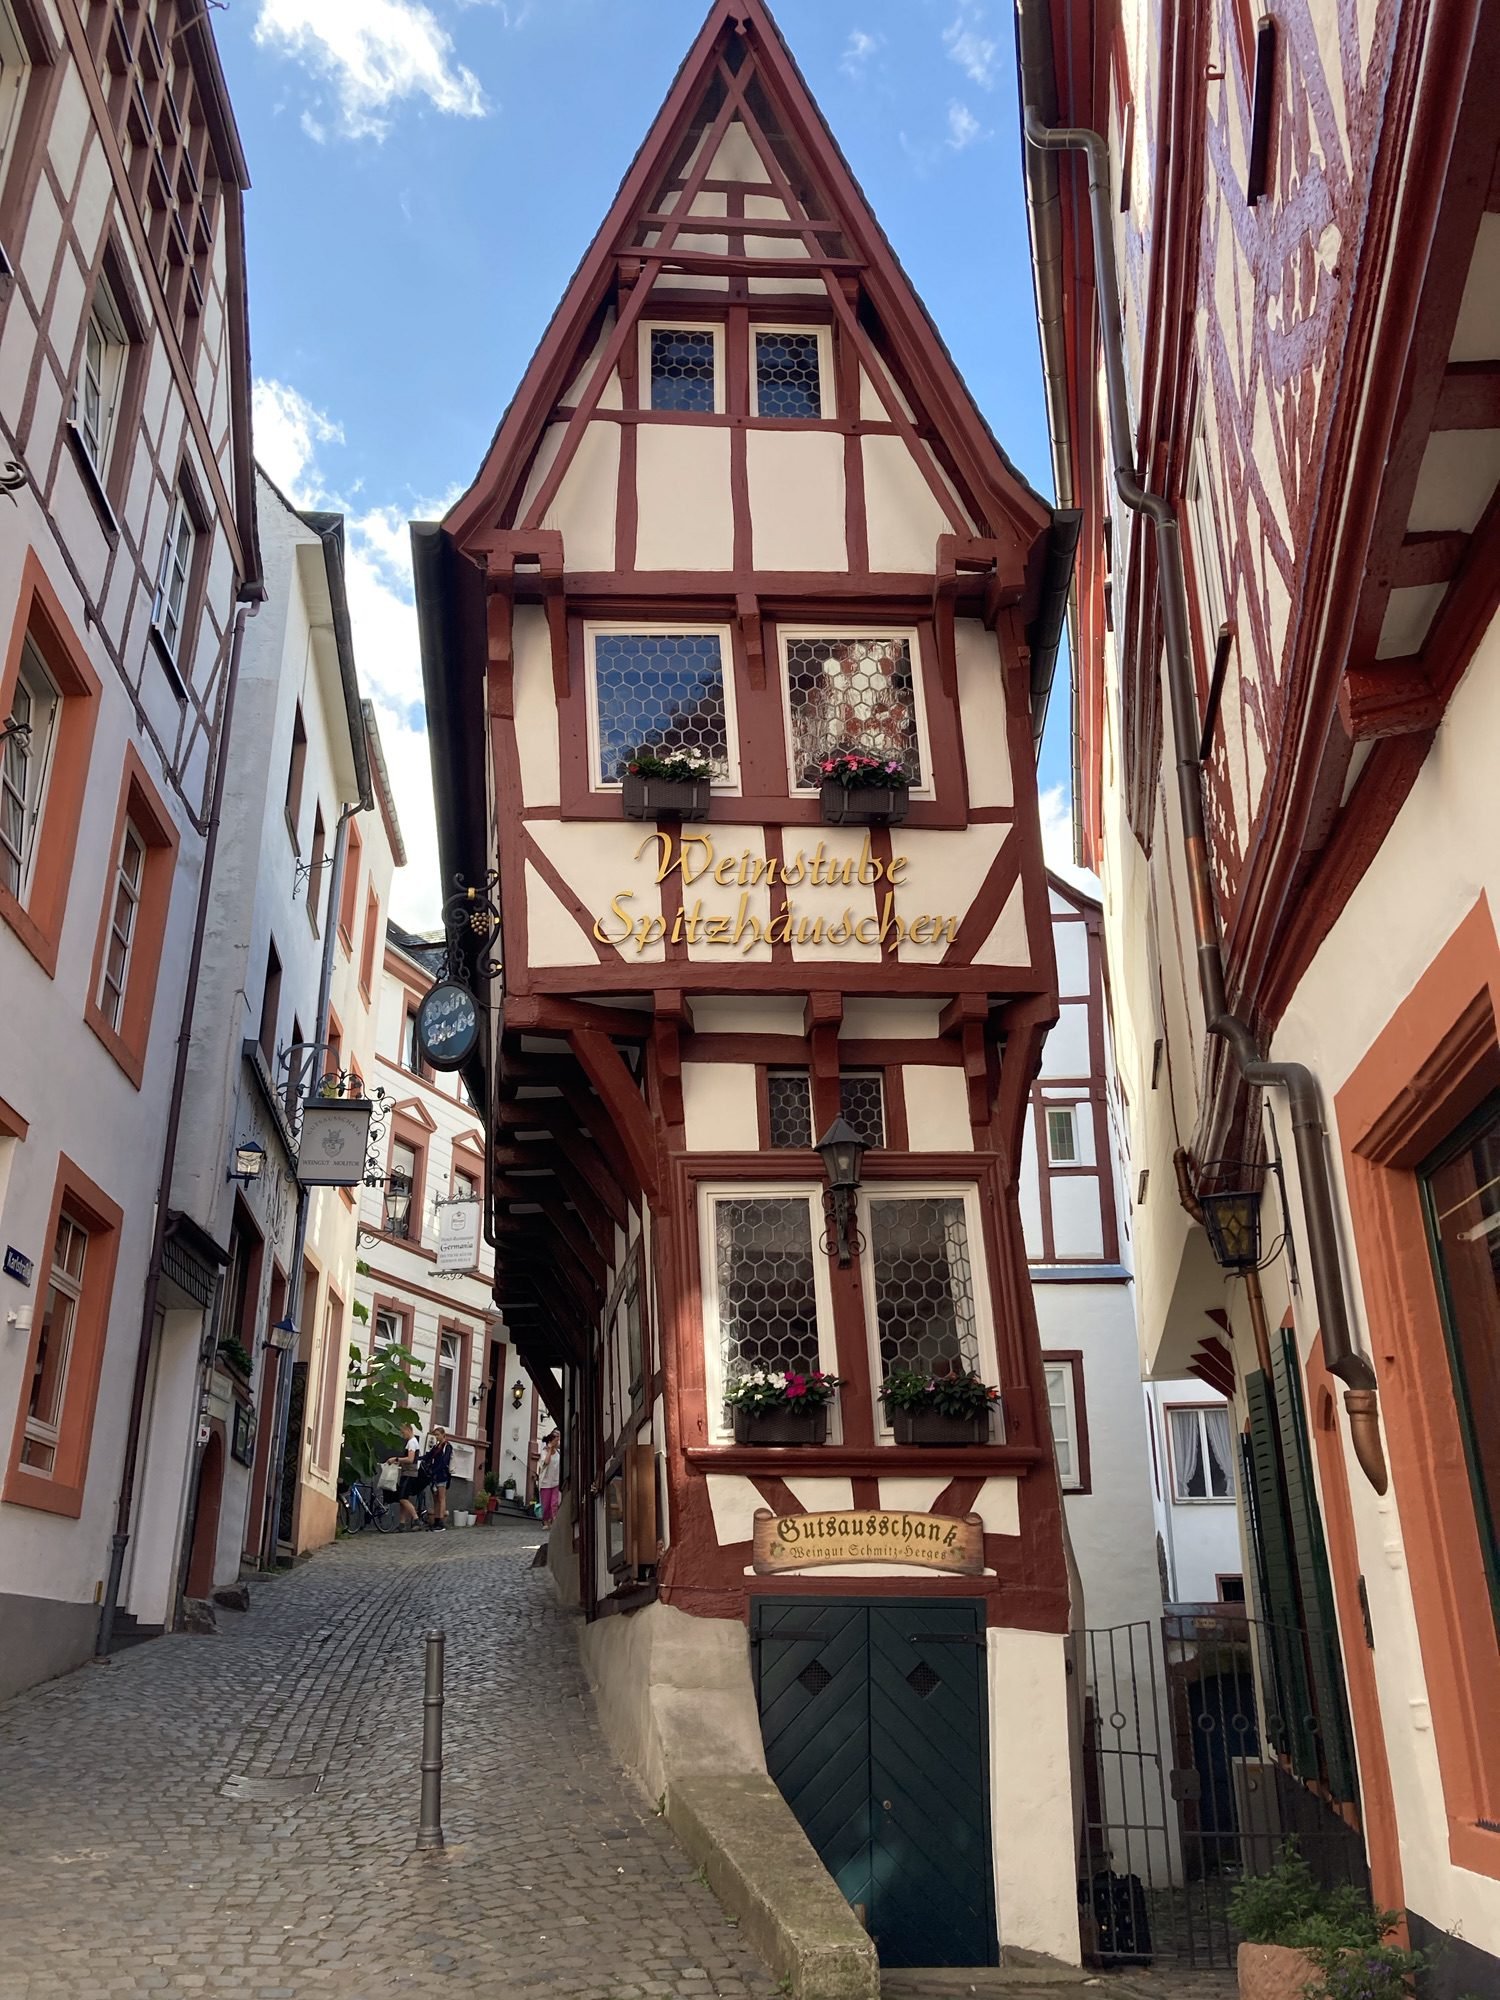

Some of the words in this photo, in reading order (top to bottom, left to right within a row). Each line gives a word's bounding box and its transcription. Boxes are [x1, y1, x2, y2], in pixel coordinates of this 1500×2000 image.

[634, 831, 910, 887] Weinstube
[593, 890, 959, 954] Spitzhäuschen
[777, 1514, 958, 1547] Gutsausschank
[790, 1545, 843, 1559] Weingut
